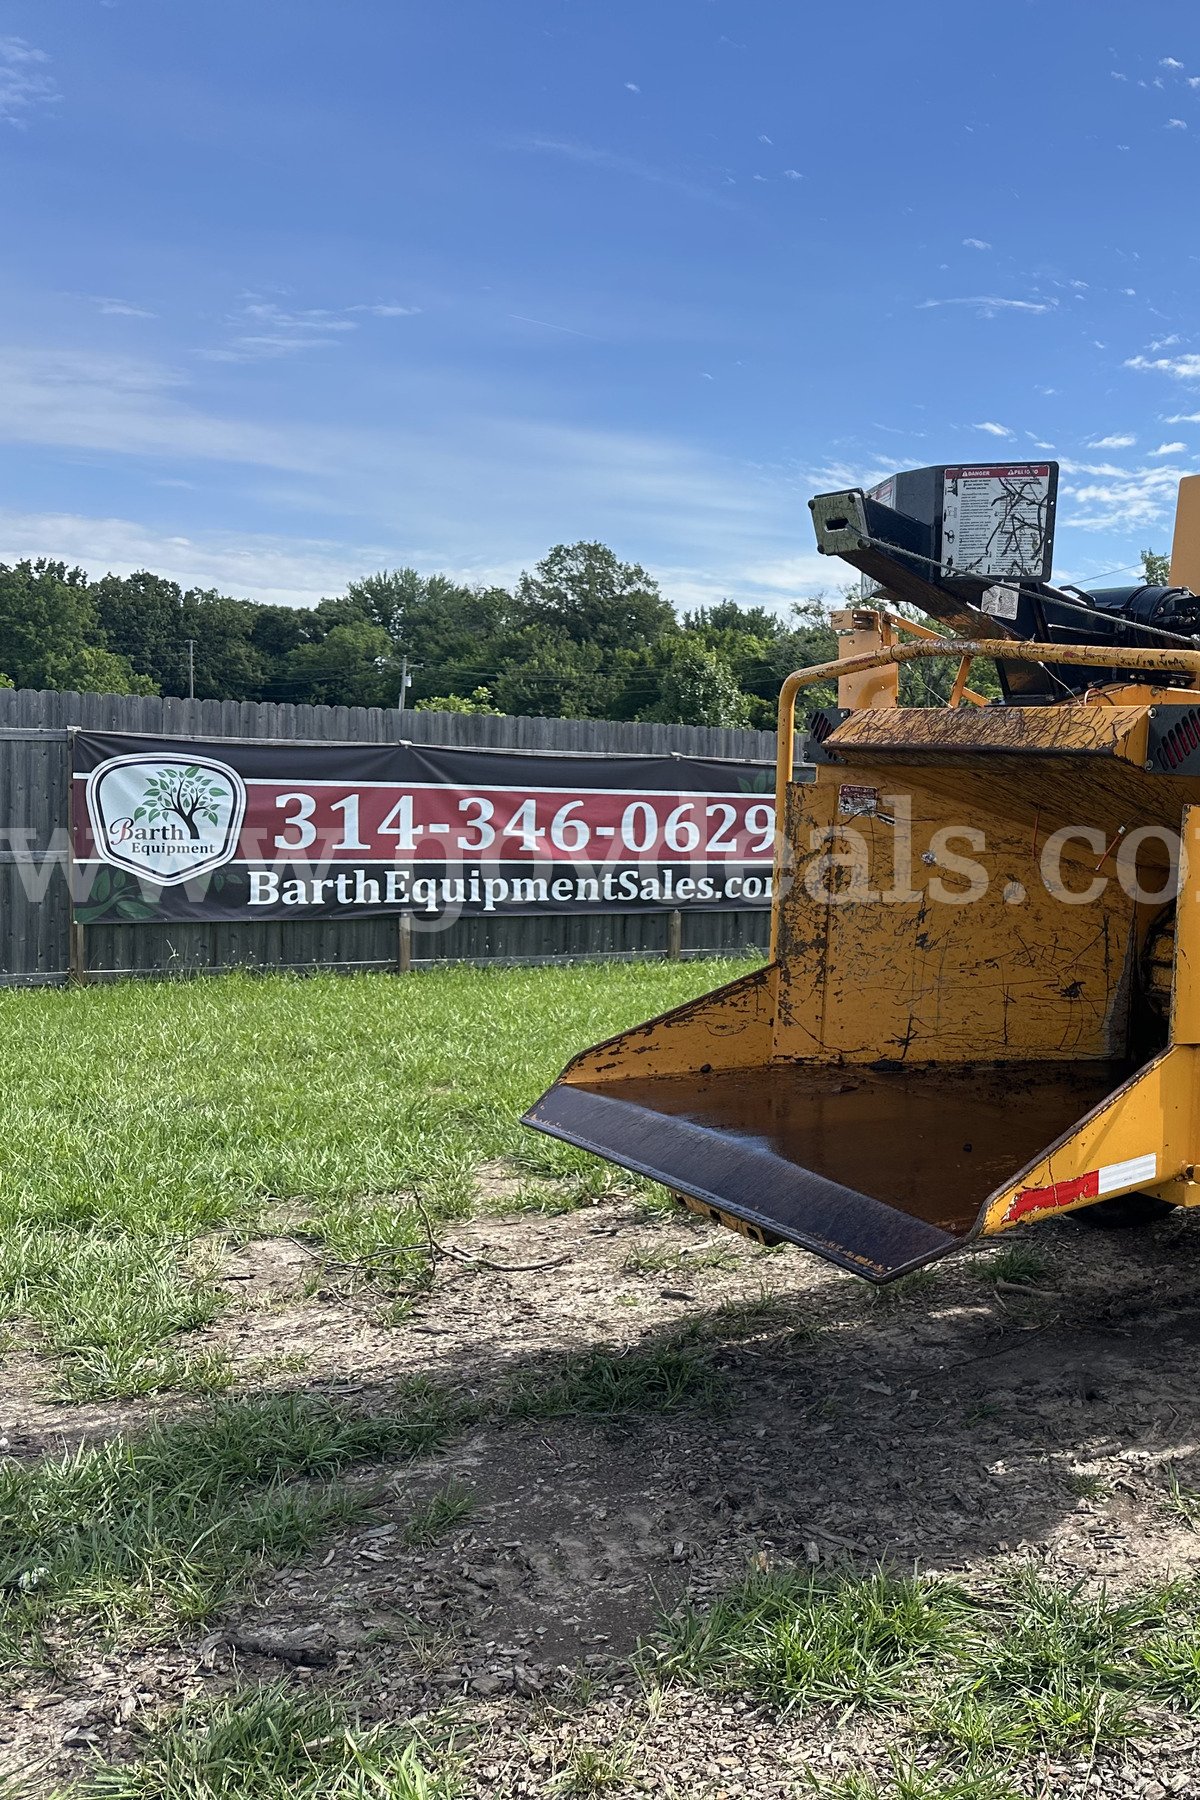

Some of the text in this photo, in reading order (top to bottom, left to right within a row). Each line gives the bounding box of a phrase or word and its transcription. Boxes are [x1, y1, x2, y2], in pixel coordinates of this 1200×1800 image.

[967, 470, 991, 478] DANGER
[109, 816, 184, 846] Barth
[274, 792, 776, 853] 314-346-0629
[131, 842, 215, 856] Equipment
